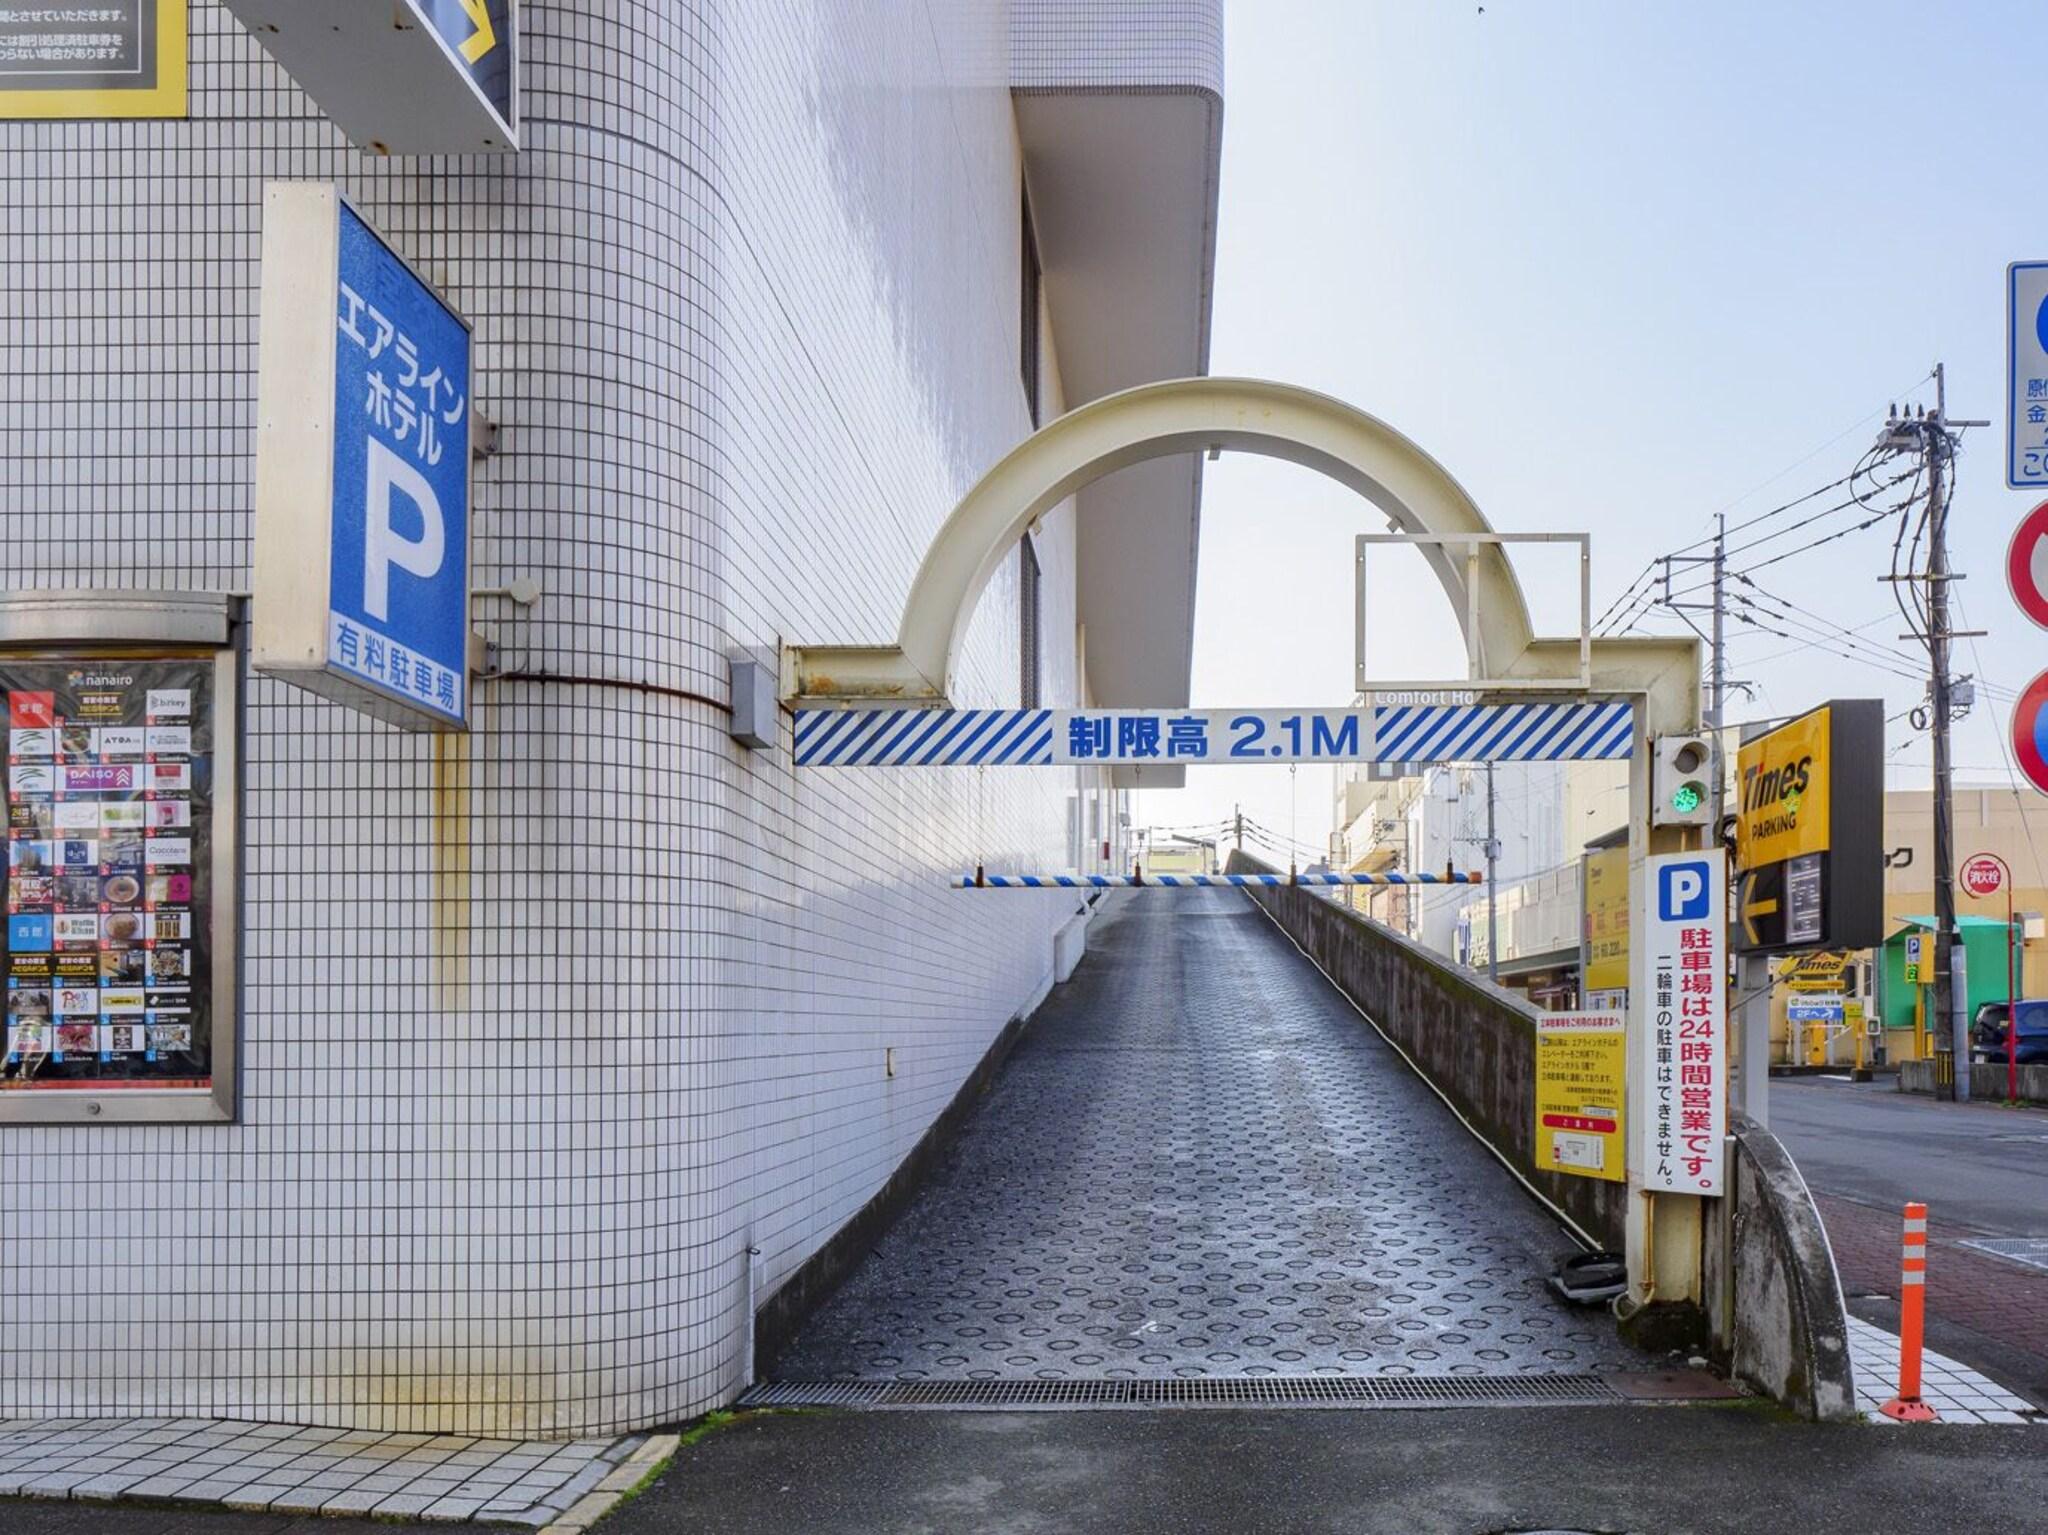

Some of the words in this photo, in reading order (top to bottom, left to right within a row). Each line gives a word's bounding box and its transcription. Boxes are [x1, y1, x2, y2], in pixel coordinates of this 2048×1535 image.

[338, 281, 464, 425] エアライン
[2028, 379, 2048, 398] 原
[366, 370, 442, 466] ホテル
[364, 434, 445, 624] P
[86, 673, 133, 686] nanairo
[337, 622, 454, 711] 有料駐車場
[1375, 690, 1447, 705] Comfort
[1069, 716, 1209, 759] 制限高
[1229, 714, 1358, 757] 2.1M
[70, 770, 114, 779] DAISO
[1743, 755, 1812, 815] Times
[1752, 811, 1797, 841] PARKING
[1670, 869, 1702, 917] P
[1657, 954, 1673, 1186] 二輪車の駐車はできません。
[1680, 928, 1714, 1188] 駐車場は24時間営業です。
